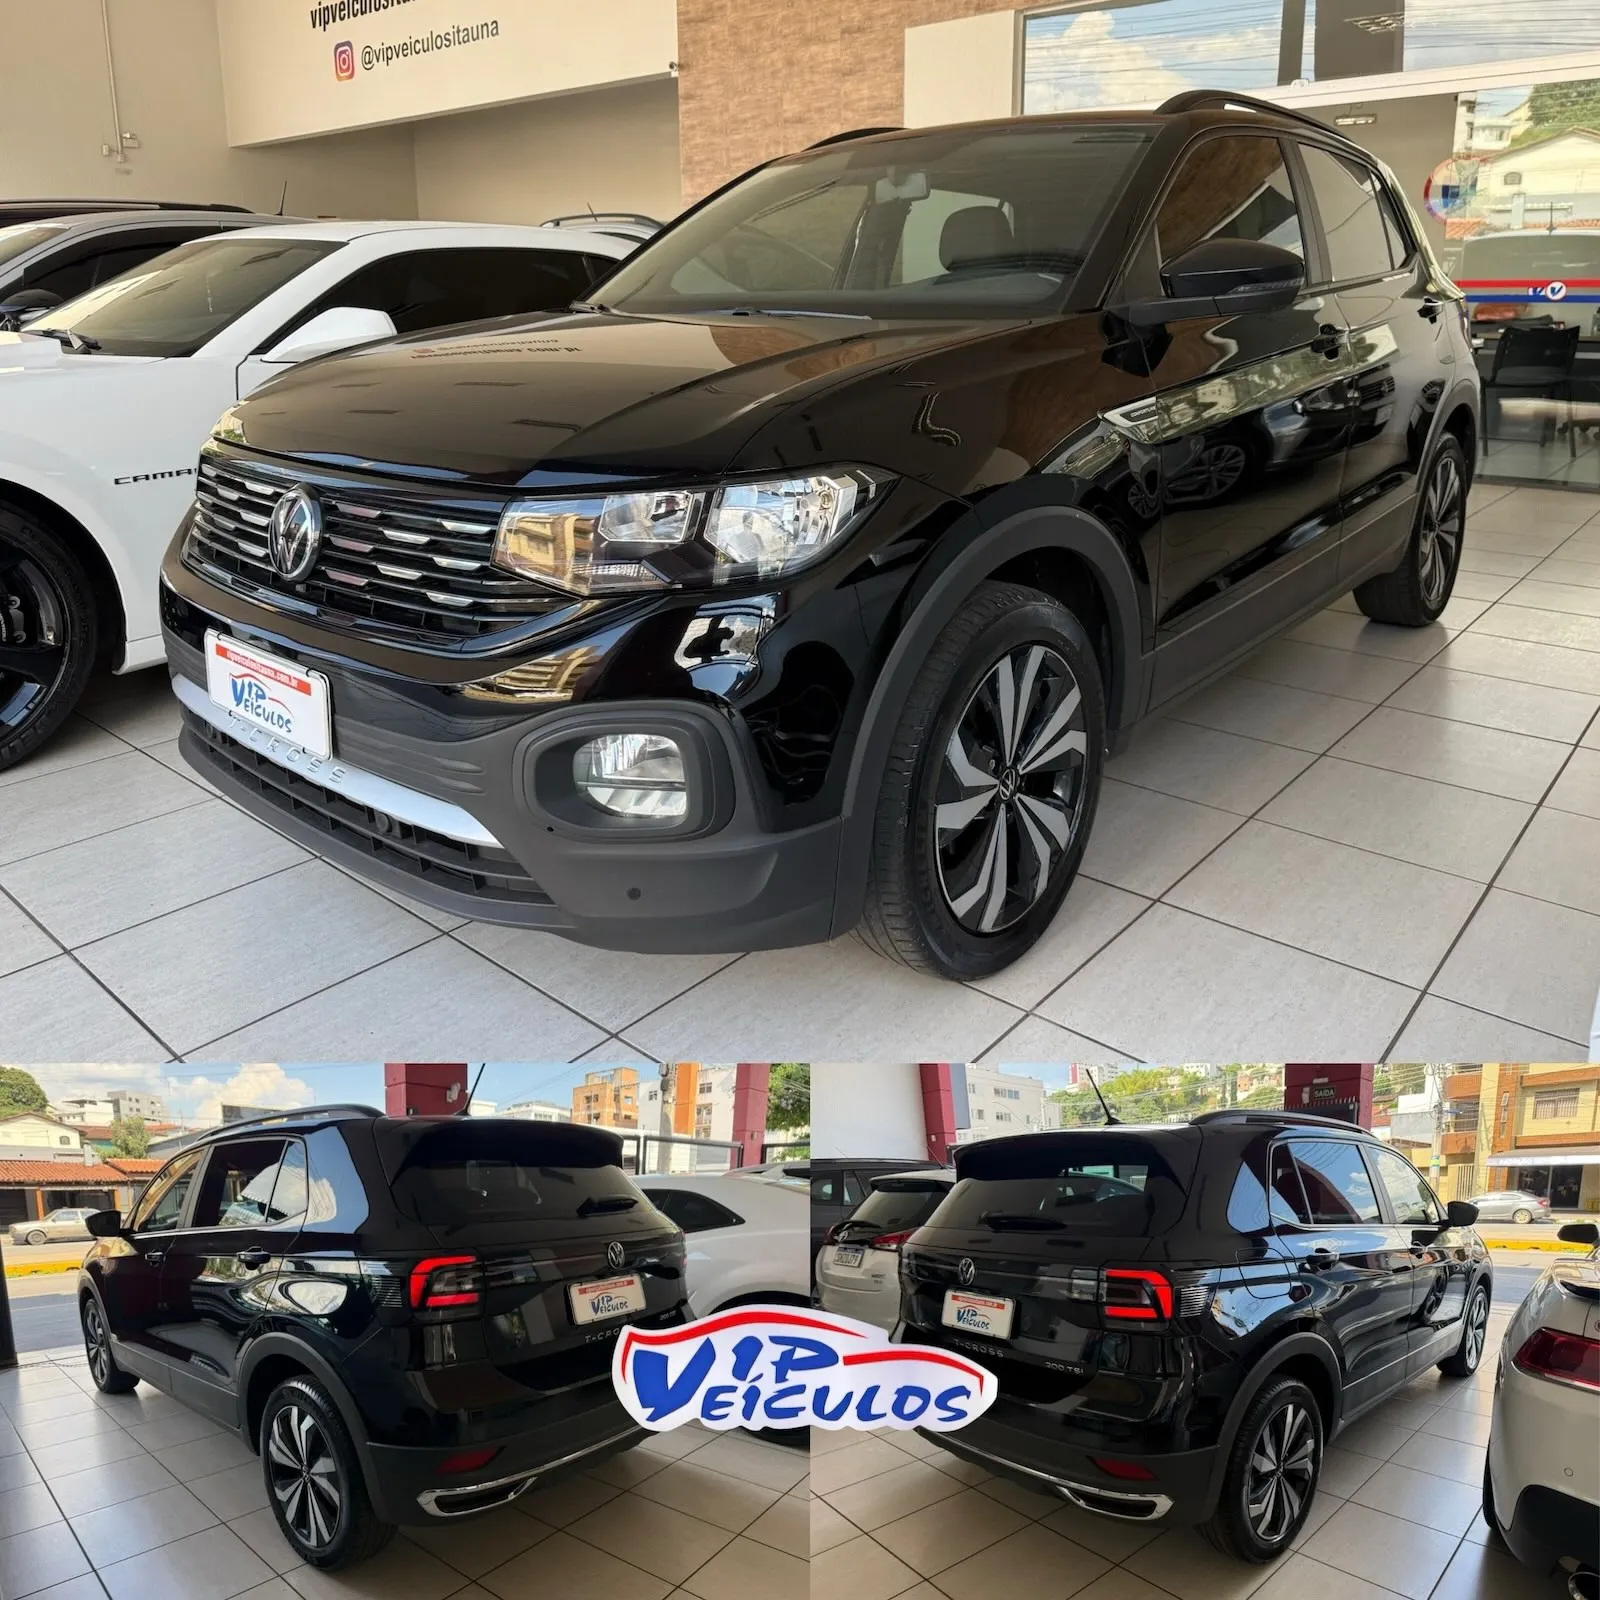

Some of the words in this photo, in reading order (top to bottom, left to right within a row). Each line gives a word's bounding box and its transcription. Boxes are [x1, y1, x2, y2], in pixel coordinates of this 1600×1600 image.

[361, 20, 499, 70] @vipveiculositauna
[114, 467, 197, 485] CAMA
[228, 716, 346, 783] T-CROSS
[585, 1324, 630, 1343] T-CRO
